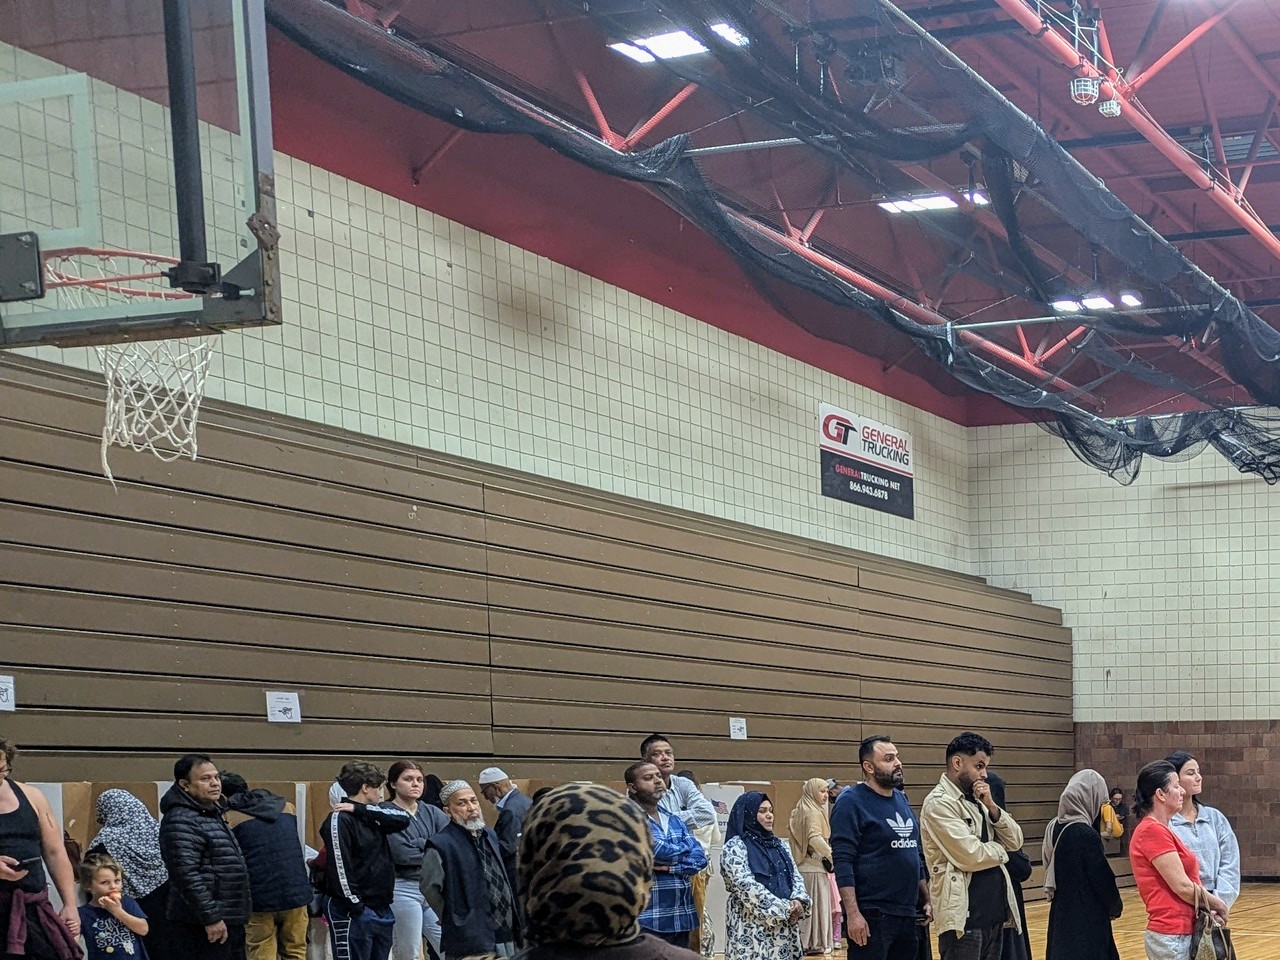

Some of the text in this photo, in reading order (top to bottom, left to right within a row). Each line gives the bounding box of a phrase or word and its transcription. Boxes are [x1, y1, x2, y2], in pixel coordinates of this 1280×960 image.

[822, 414, 858, 445] GT
[861, 425, 910, 453] GENERAL
[861, 439, 909, 466] TRUCKING
[890, 838, 918, 848] adidas
